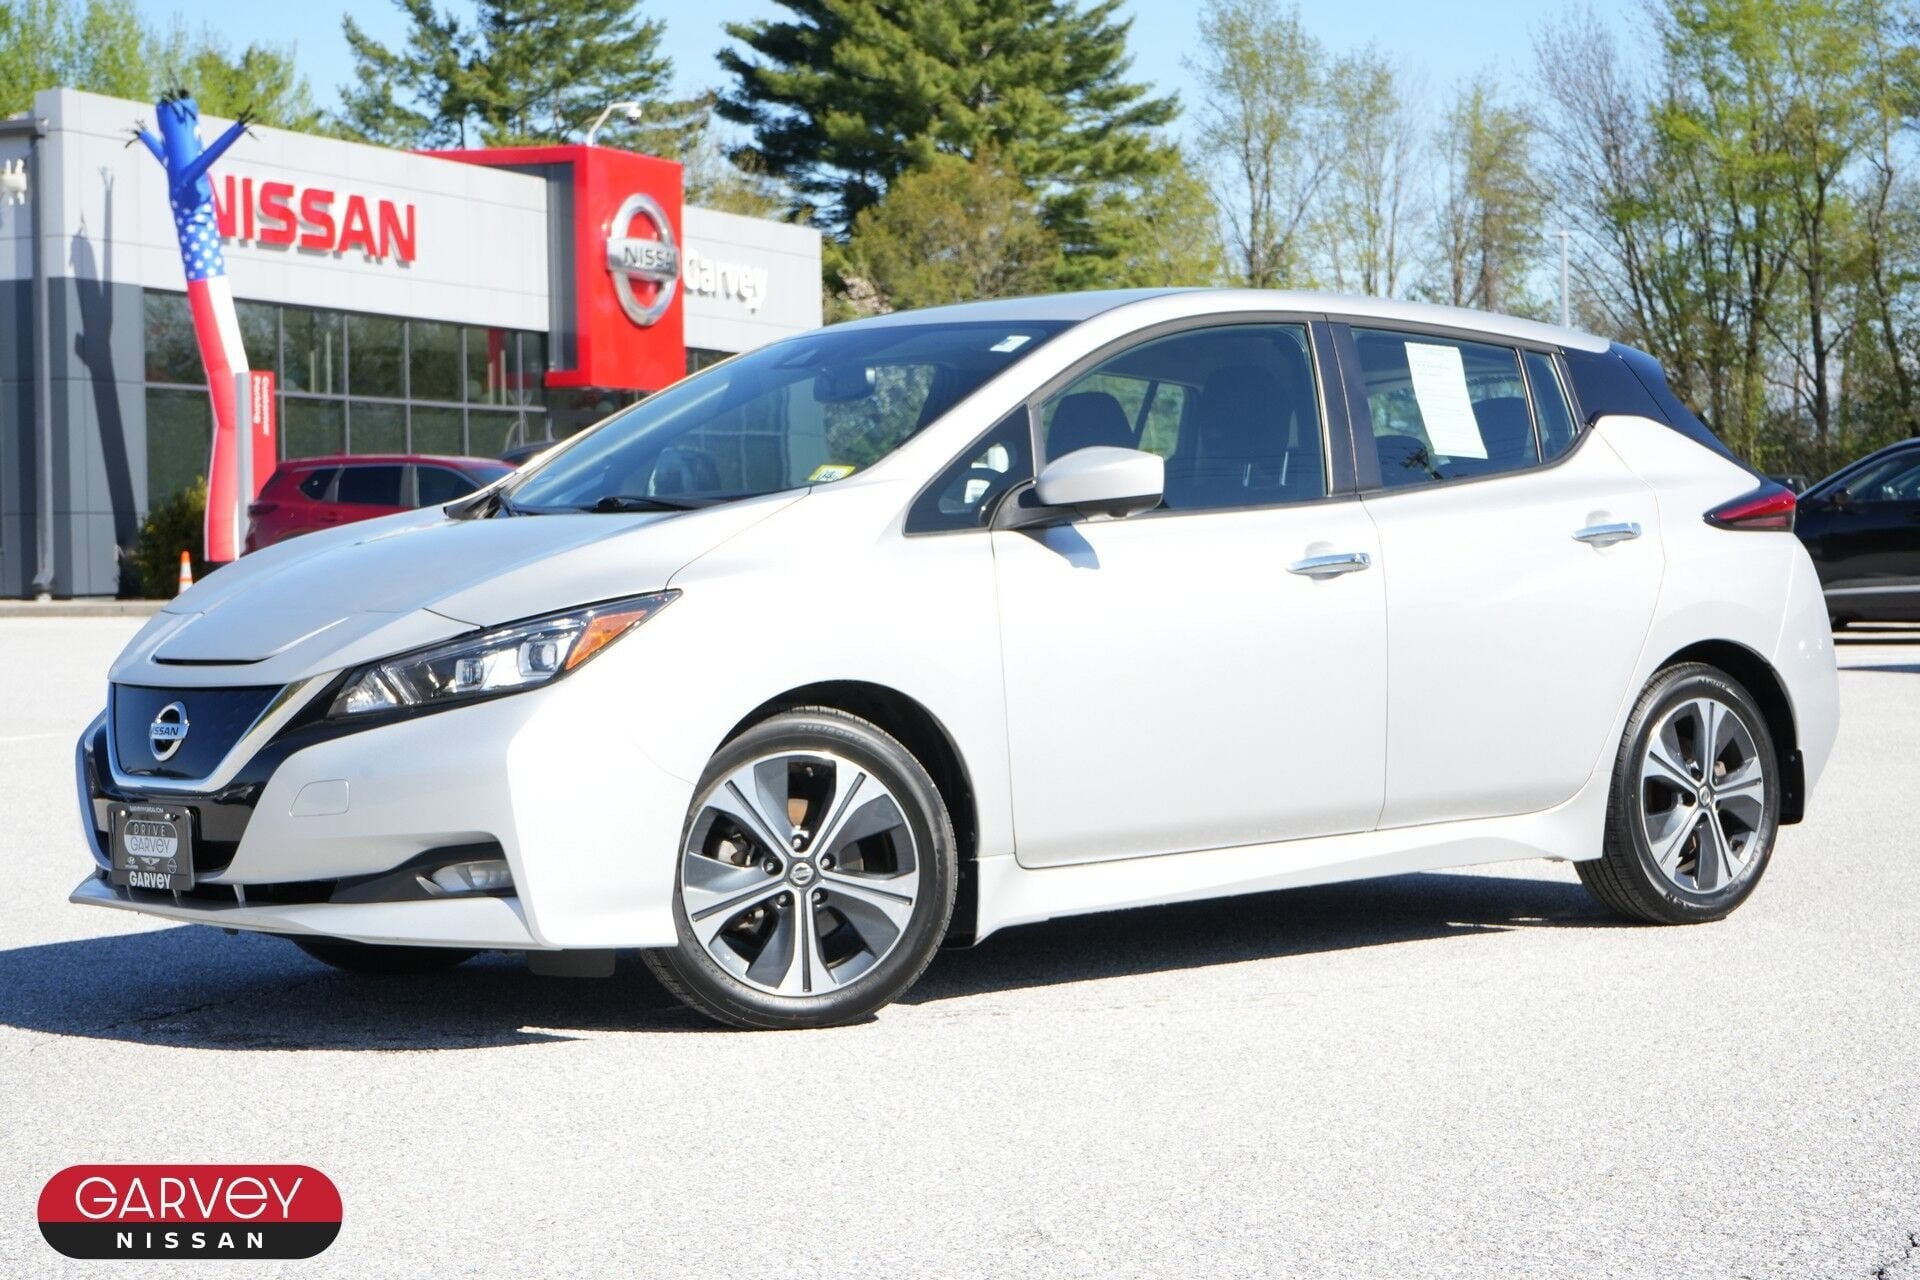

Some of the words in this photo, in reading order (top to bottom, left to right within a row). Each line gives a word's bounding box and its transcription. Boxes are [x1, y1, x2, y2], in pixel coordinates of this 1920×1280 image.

[207, 174, 416, 262] NISSAN
[683, 248, 768, 309] Garvey
[134, 823, 166, 837] DRIVE
